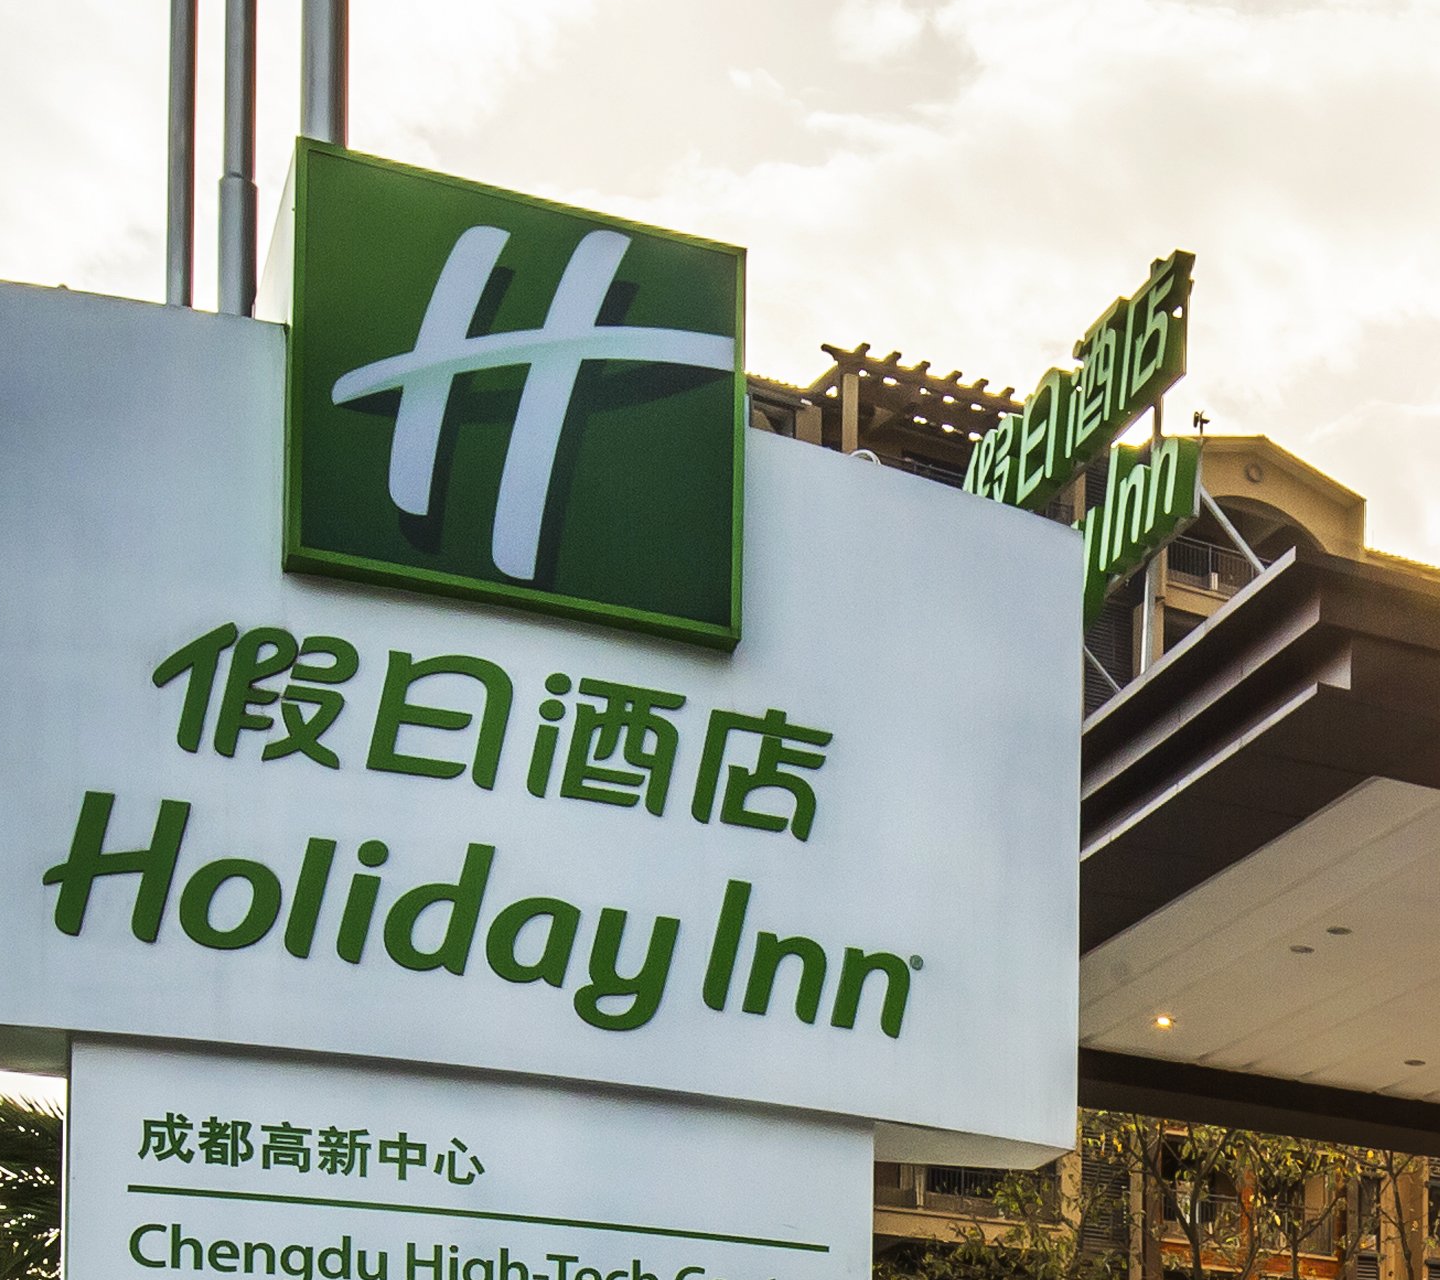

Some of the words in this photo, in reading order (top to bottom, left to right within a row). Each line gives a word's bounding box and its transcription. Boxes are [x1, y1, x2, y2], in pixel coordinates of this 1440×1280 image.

[1099, 436, 1196, 573] Inn
[153, 622, 834, 842] 假日酒店
[42, 791, 681, 1032] Holiday
[702, 879, 912, 1039] Inn
[137, 1112, 486, 1186] 成都高新中心
